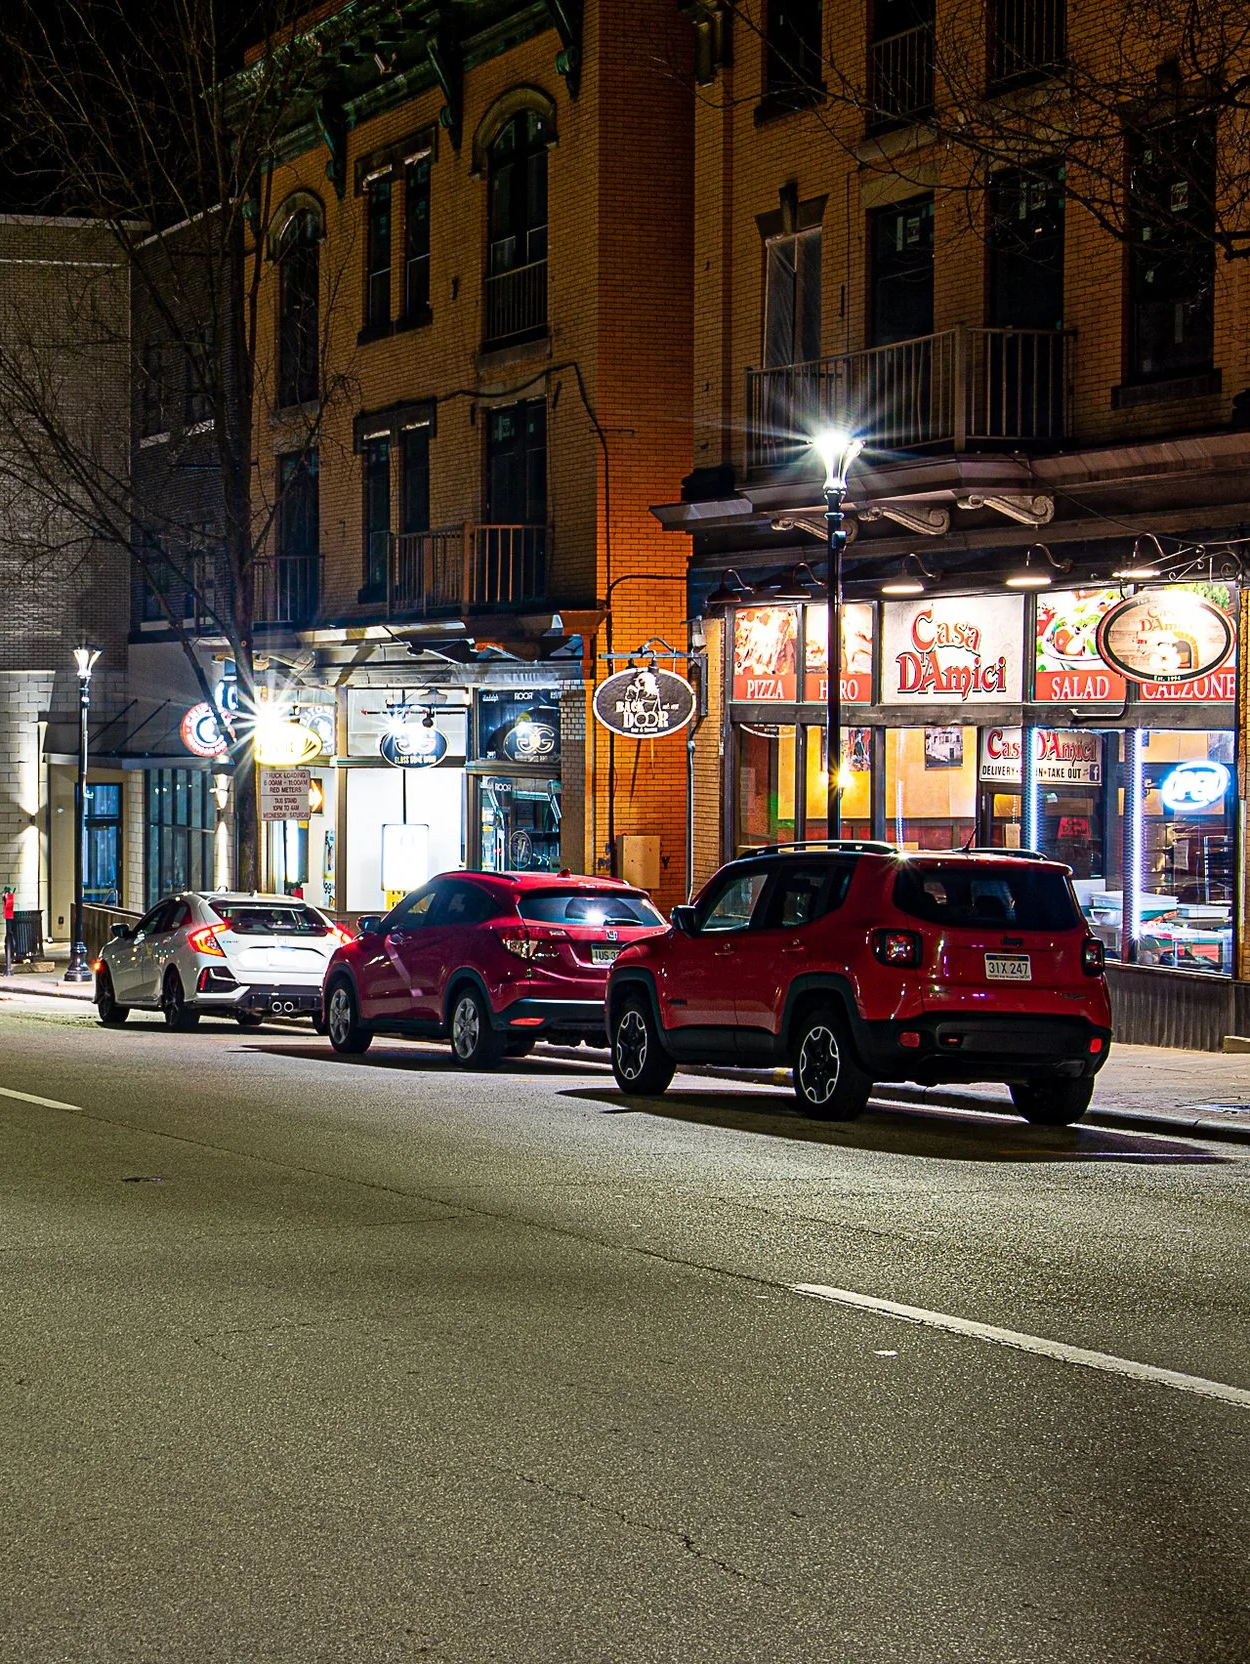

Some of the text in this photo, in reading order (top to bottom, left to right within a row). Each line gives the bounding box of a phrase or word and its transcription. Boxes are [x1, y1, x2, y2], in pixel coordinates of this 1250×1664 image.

[911, 606, 981, 655] Casa
[895, 649, 1007, 700] D'Amici
[746, 679, 785, 699] PIZZA
[819, 679, 859, 700] HRO
[1051, 675, 1110, 700] SALAD
[615, 700, 645, 712] BACK
[623, 711, 669, 728] DOOR
[987, 729, 1022, 760] Cas
[983, 765, 1015, 776] DELIVERY
[1047, 767, 1065, 778] TAKE
[1067, 768, 1081, 779] OUT
[988, 962, 1028, 974] 31X 247
